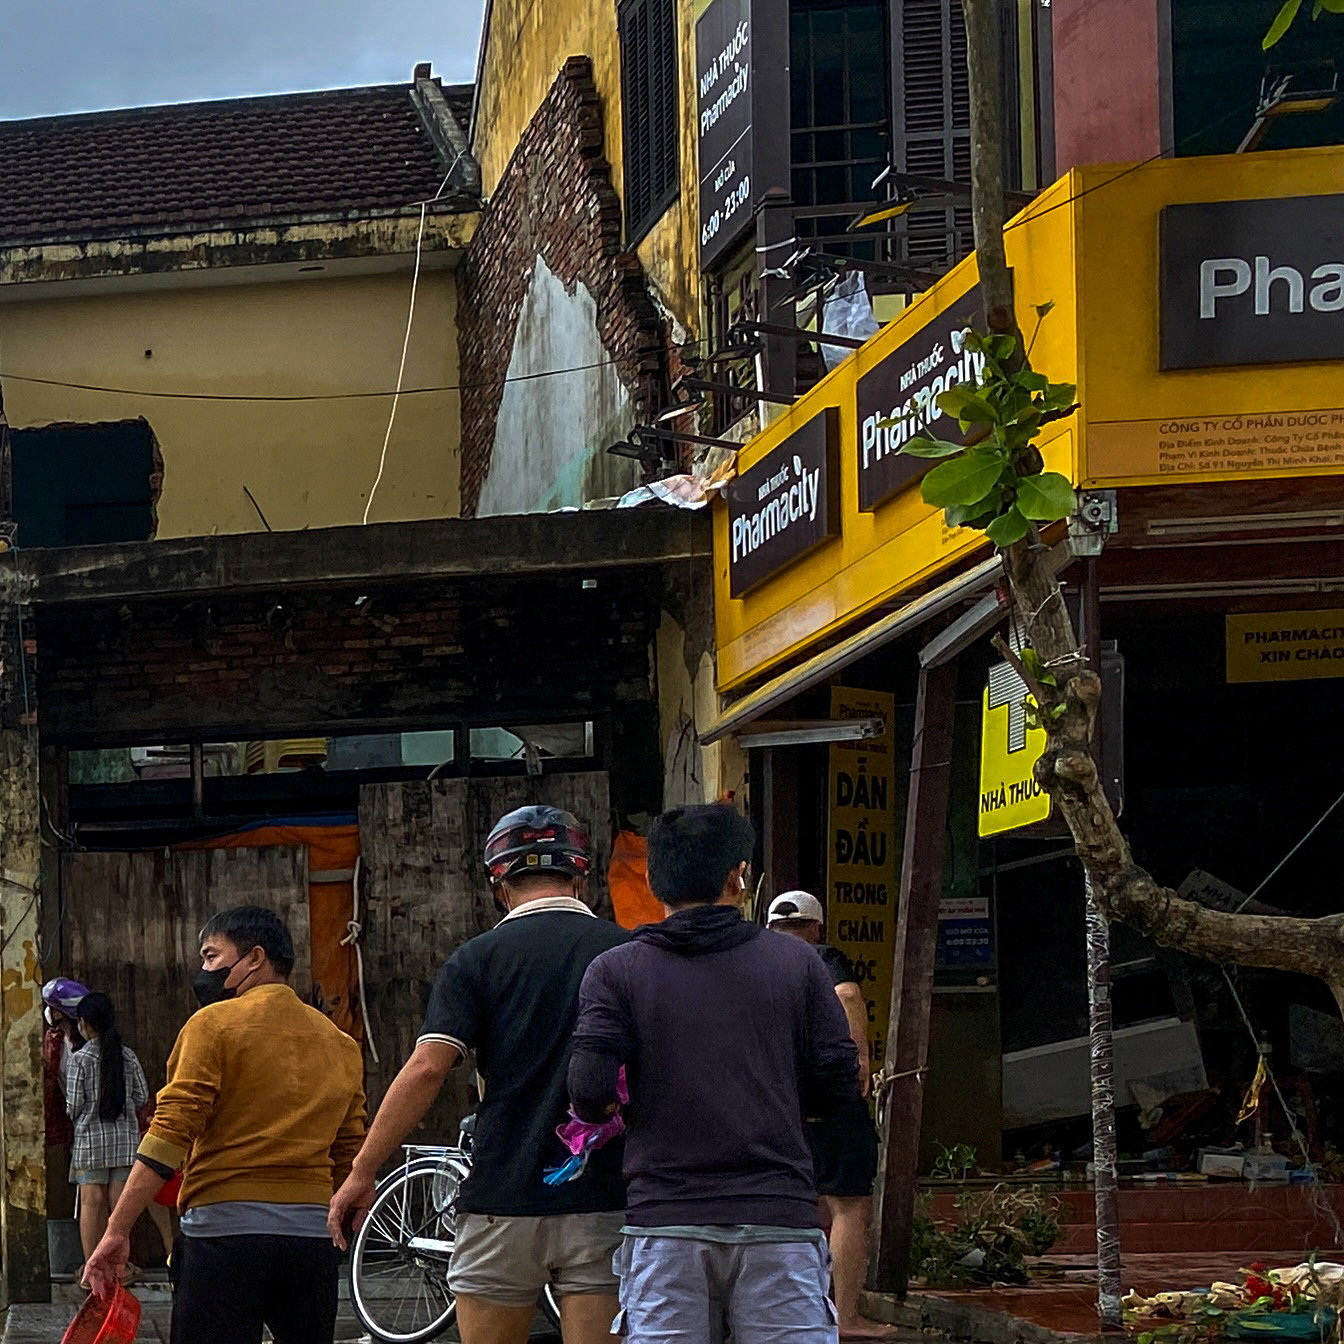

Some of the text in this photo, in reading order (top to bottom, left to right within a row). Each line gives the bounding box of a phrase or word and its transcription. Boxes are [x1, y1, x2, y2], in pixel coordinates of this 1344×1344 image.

[700, 20, 749, 99] NHÀ THUỐC
[701, 62, 750, 138] Pharmacity
[701, 215, 720, 247] 6:00
[724, 175, 750, 221] 23:00
[899, 342, 945, 393] NHÀ THUỐC
[1159, 421, 1200, 435] CÔNG
[1203, 421, 1220, 433] TY
[1223, 415, 1243, 431] CỔ
[1287, 414, 1329, 429] DƯỢC
[732, 456, 820, 564] Pharmacity
[1260, 650, 1291, 664] XIN
[836, 756, 888, 811] DẪN
[980, 781, 1007, 814] NHÀ
[834, 881, 888, 906] TRONG
